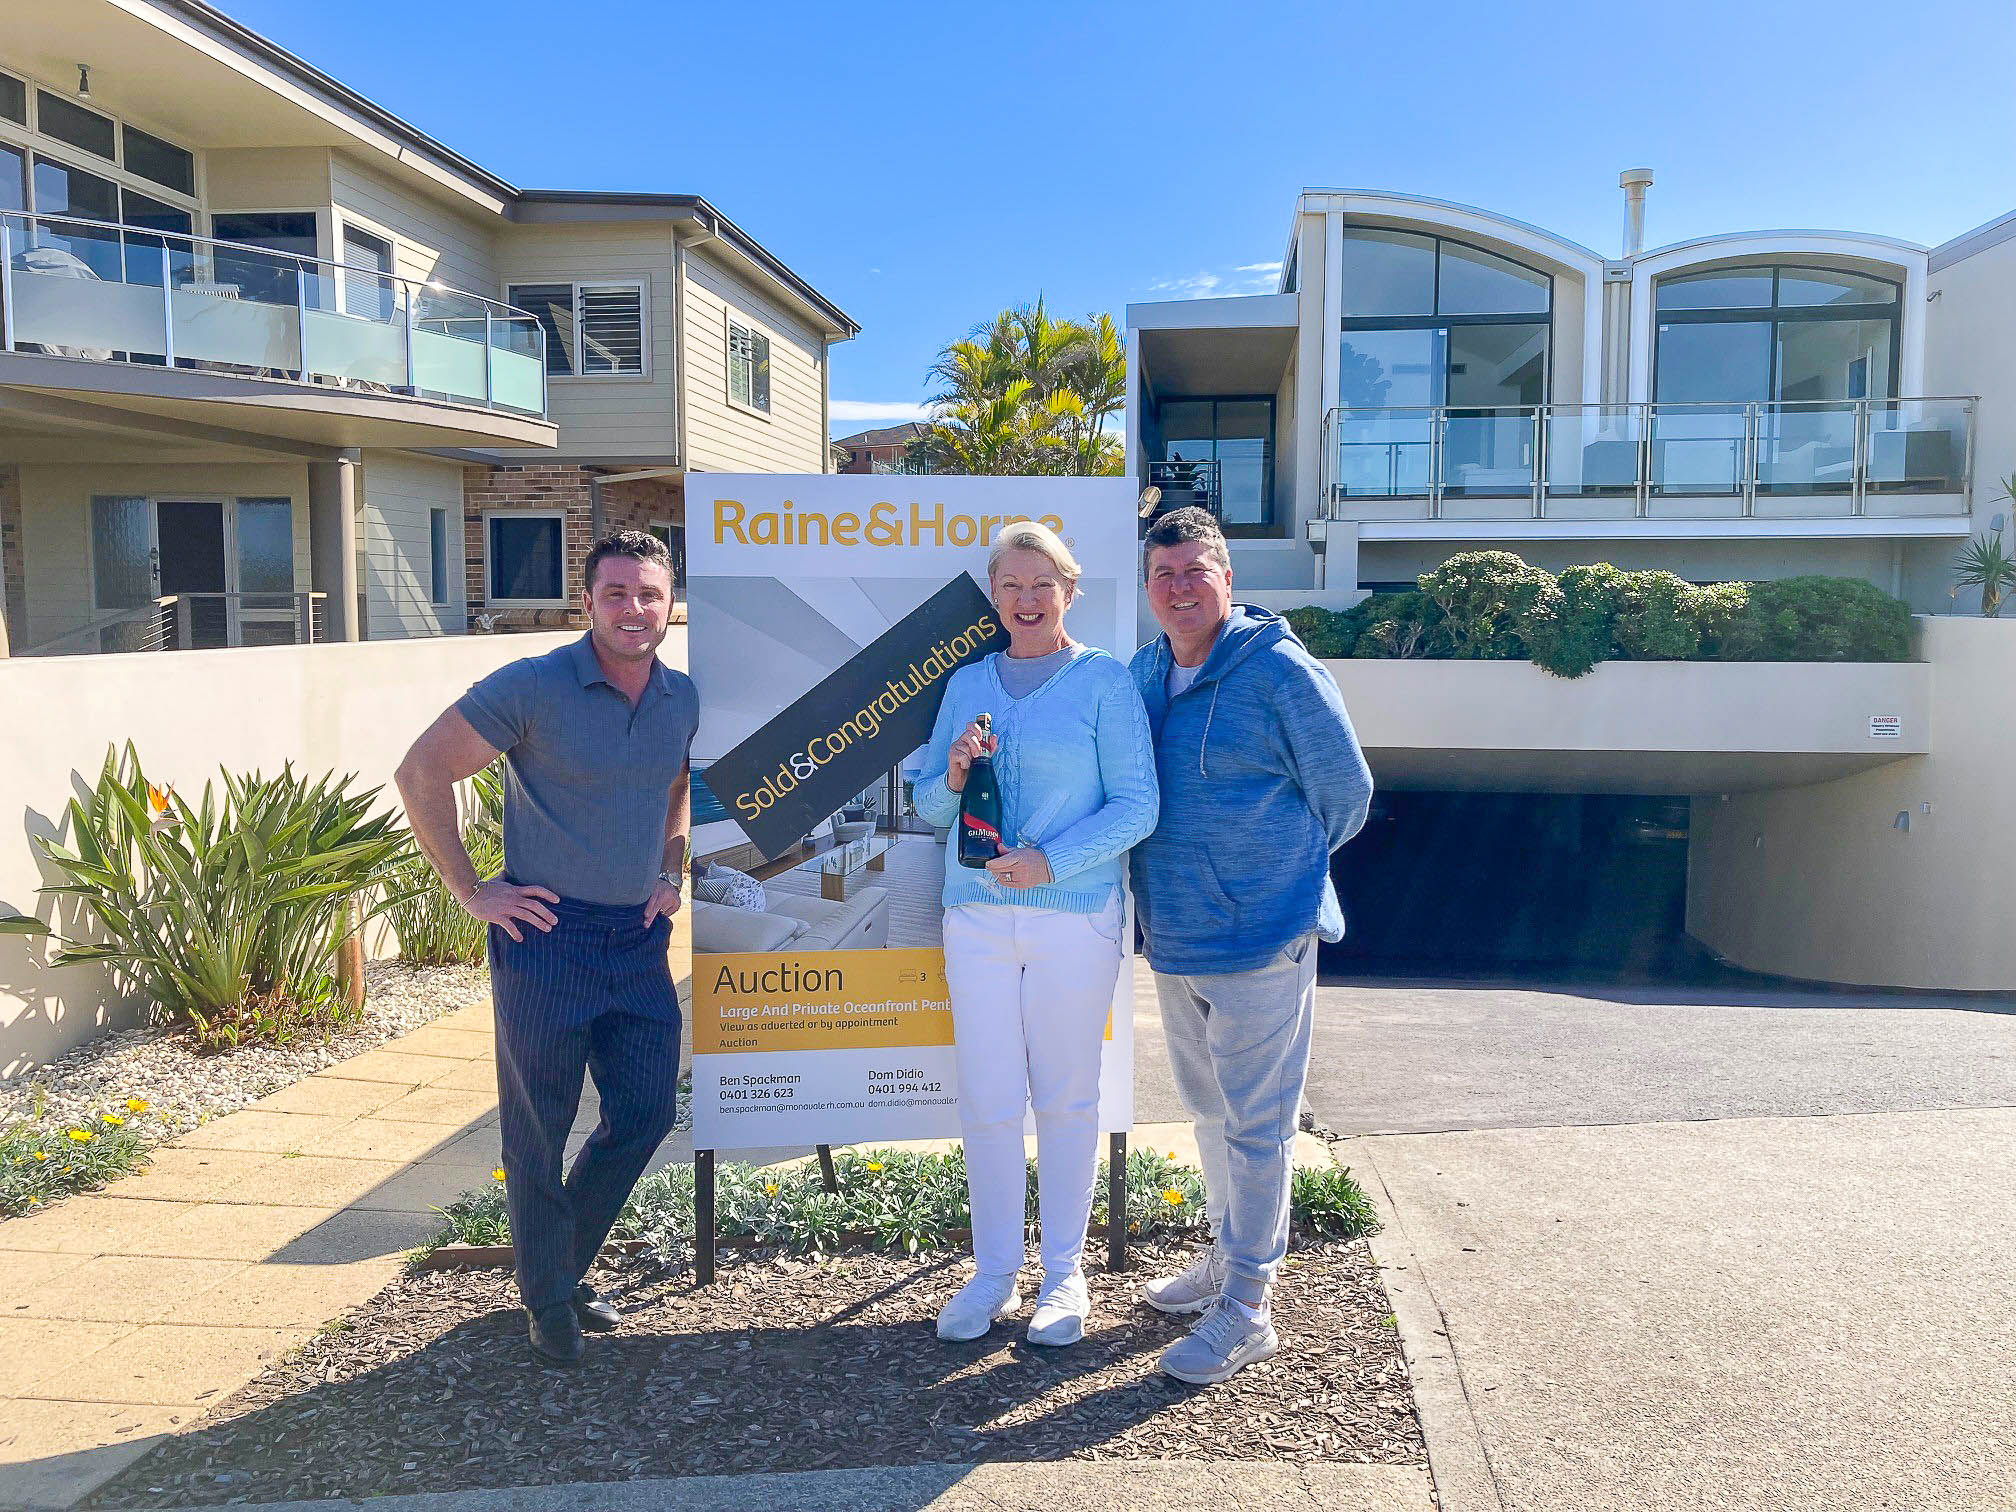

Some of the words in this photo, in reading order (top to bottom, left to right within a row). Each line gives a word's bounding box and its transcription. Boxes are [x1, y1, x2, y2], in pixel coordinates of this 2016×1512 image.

[735, 615, 998, 821] Sold&Congratulations
[712, 962, 843, 995] Auction
[920, 972, 927, 982] 3
[719, 1005, 758, 1020] Large
[761, 1003, 789, 1017] And
[792, 1001, 841, 1016] Private
[844, 999, 918, 1014] Oceanfront
[719, 1022, 745, 1032] View
[761, 1019, 805, 1031] adverted
[807, 1021, 818, 1029] or
[820, 1018, 833, 1031] by
[835, 1017, 898, 1030] appointment
[719, 1038, 758, 1048] Auction
[720, 1076, 741, 1086] Ben
[743, 1073, 801, 1088] Spackman
[868, 1070, 894, 1080] Dom
[896, 1068, 924, 1079] Didio
[720, 1089, 748, 1100] 0401
[750, 1088, 771, 1099] 326
[773, 1087, 794, 1098] 623
[868, 1084, 896, 1094] 0401
[898, 1083, 919, 1093] 994
[921, 1082, 942, 1092] 412
